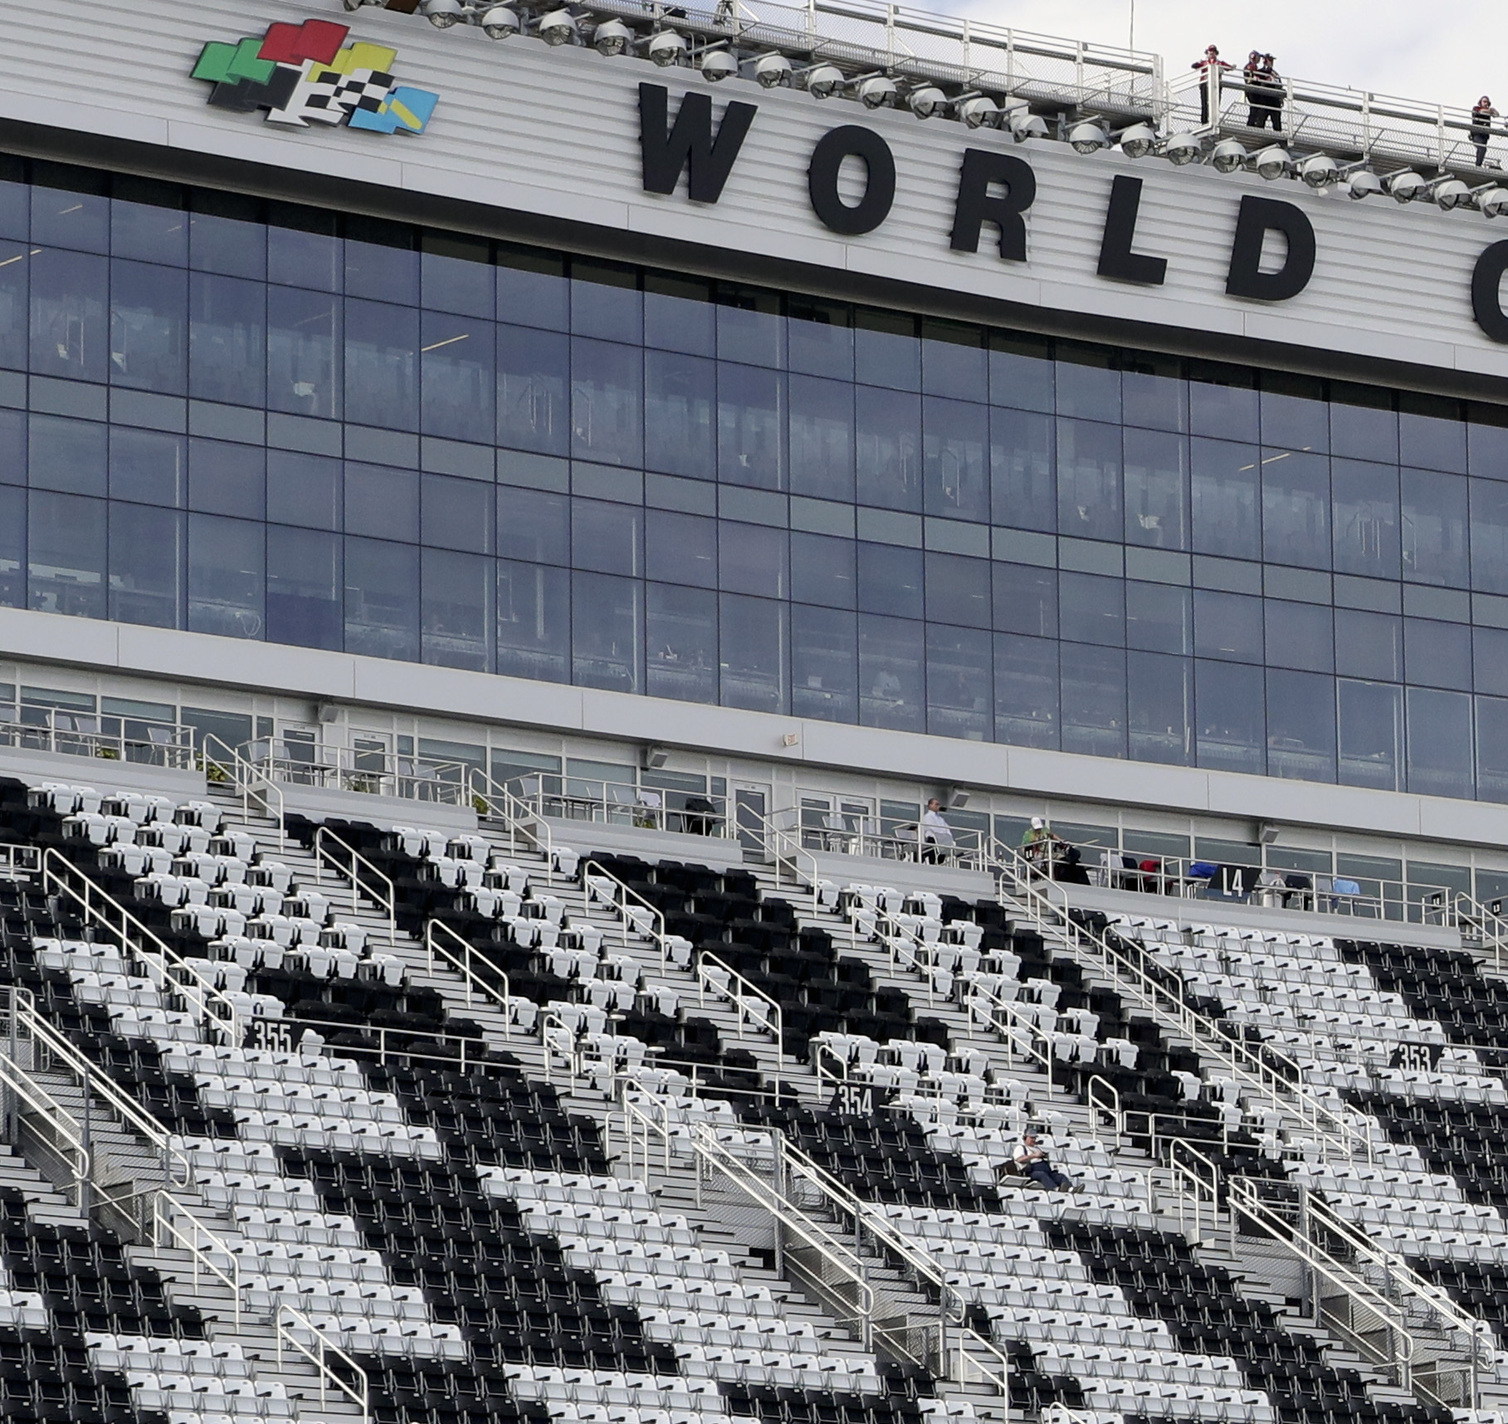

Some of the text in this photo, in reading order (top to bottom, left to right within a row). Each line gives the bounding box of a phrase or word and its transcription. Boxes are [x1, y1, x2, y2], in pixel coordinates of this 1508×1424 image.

[638, 81, 1316, 303] WORLD
[1222, 867, 1244, 897] L4
[254, 1020, 292, 1051] 355
[1400, 1044, 1432, 1072] 353
[838, 1085, 873, 1116] 354
